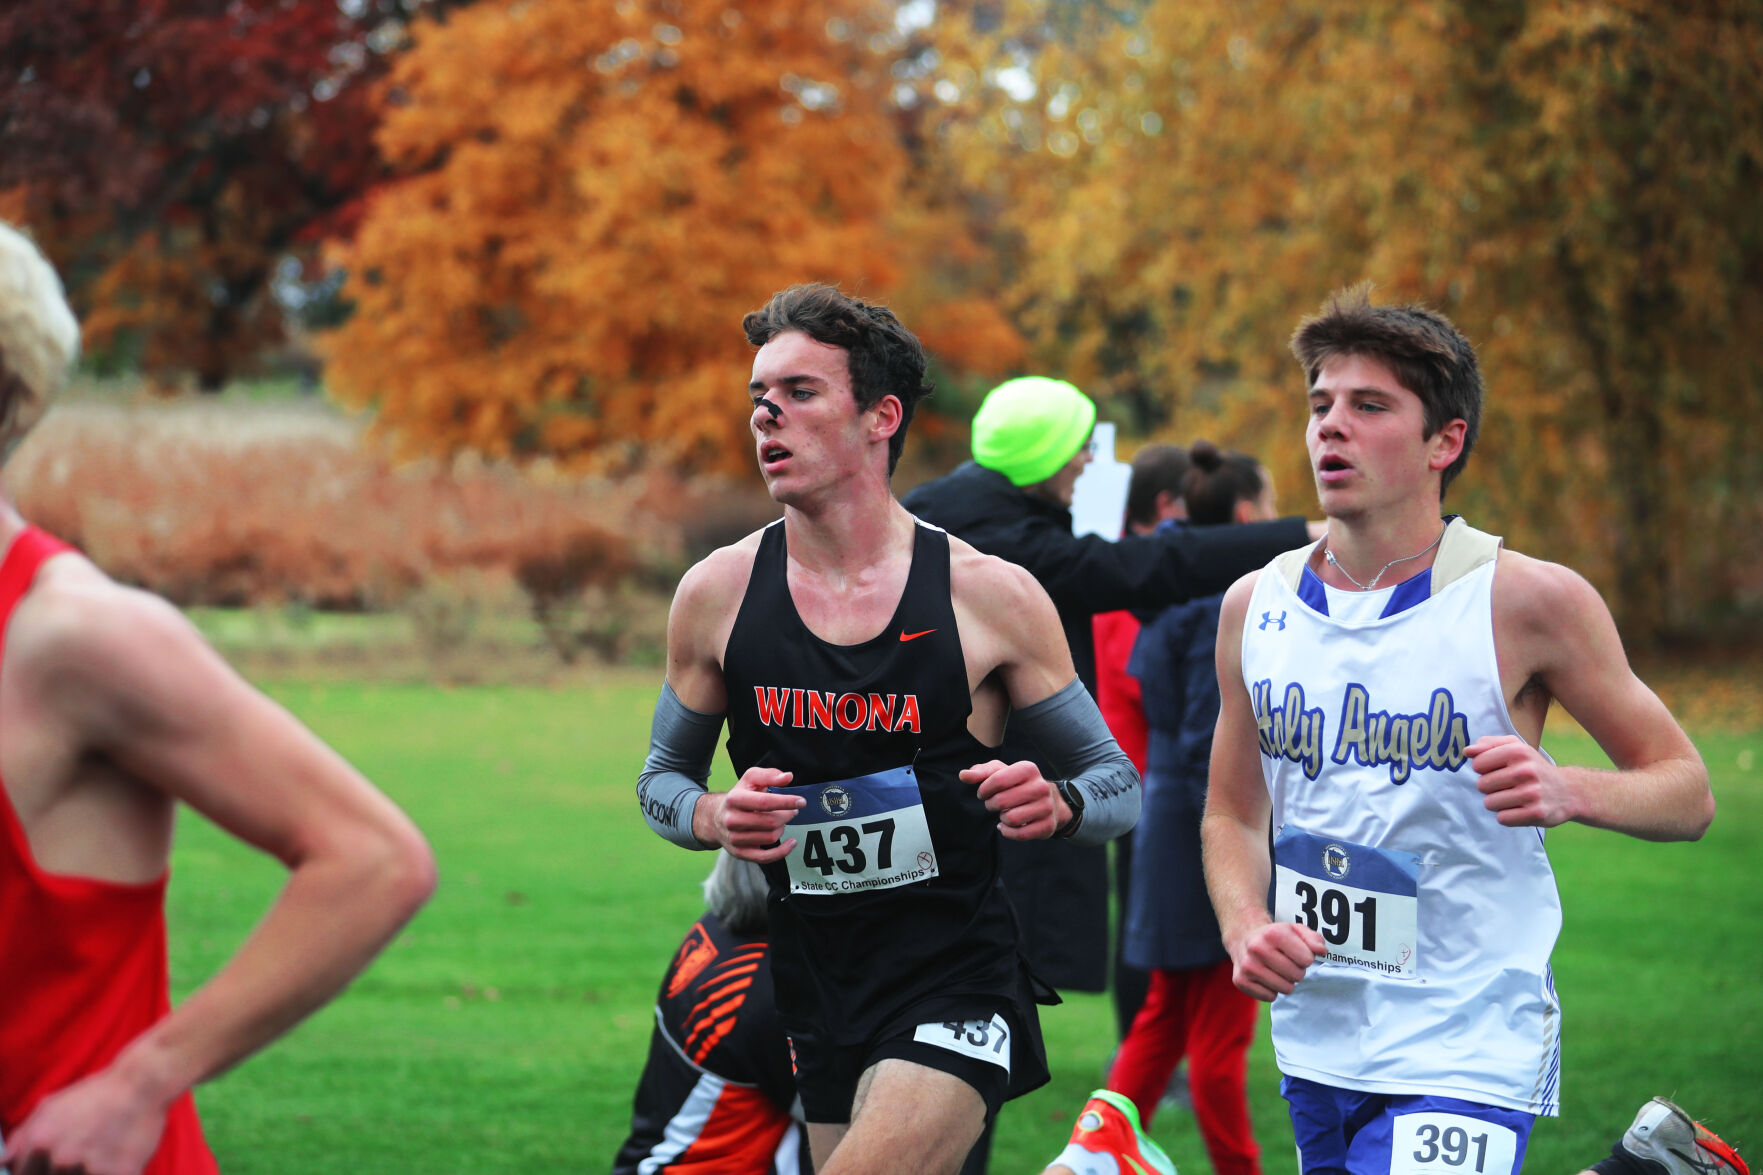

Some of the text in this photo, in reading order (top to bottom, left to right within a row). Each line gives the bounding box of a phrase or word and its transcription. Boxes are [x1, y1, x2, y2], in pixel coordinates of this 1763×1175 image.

[753, 686, 922, 733] WINONA
[1253, 678, 1470, 785] Holy Angels
[803, 817, 896, 876] 437
[801, 869, 925, 891] State CC Championships
[1295, 880, 1377, 952] 391
[1321, 948, 1402, 974] hampionships
[942, 1020, 1008, 1054] 437
[1412, 1124, 1488, 1174] 391
